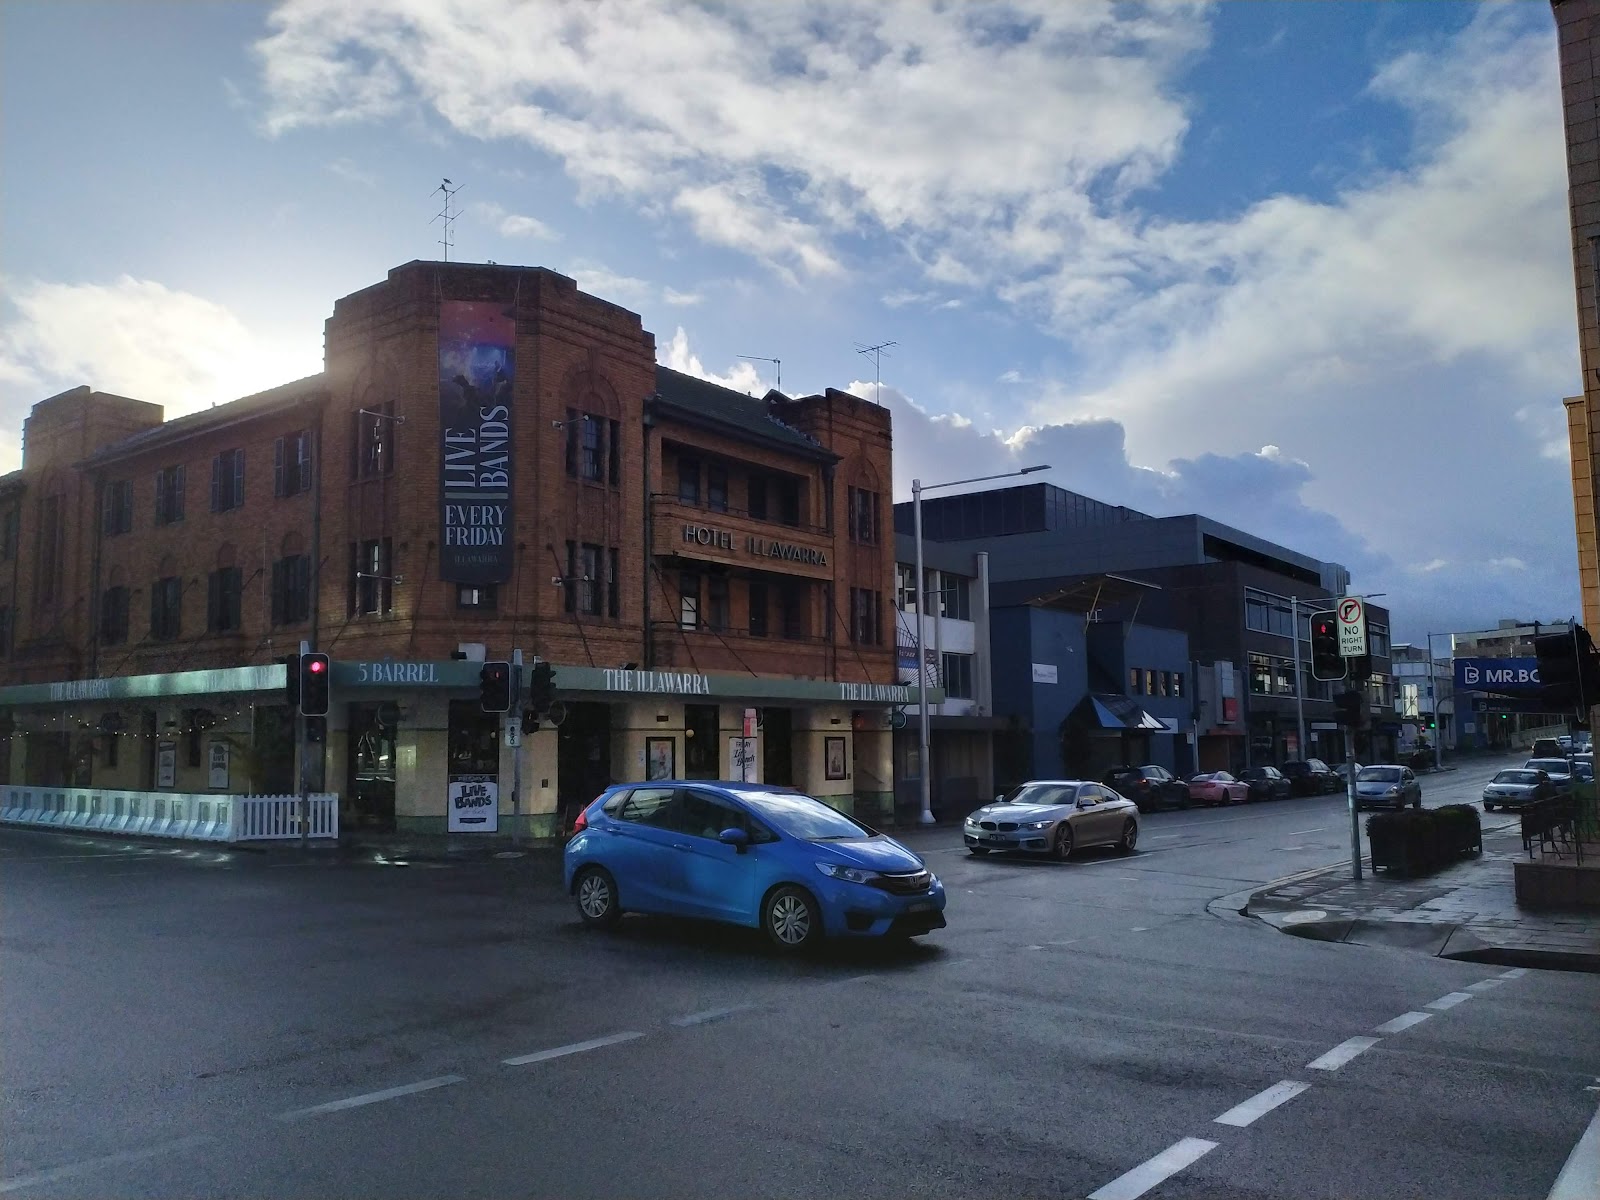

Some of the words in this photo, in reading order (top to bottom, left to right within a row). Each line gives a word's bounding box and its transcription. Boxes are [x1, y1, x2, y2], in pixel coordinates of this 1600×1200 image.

[480, 405, 509, 487] BANDS
[445, 427, 476, 487] LIVE
[445, 505, 507, 525] EVERY
[445, 527, 507, 546] FRIDAY
[683, 523, 737, 550] HOTEL
[748, 535, 828, 566] ILLAWARRA
[1344, 625, 1359, 635] NO
[1341, 636, 1363, 644] RIGHT
[1343, 645, 1363, 653] TURN
[358, 663, 368, 682] 5
[372, 663, 439, 682] BARREL
[603, 669, 633, 691] THE
[636, 671, 710, 694] ILLAWARRA
[839, 682, 859, 700] THE
[860, 684, 909, 702] ILLAWARRA
[461, 785, 487, 798] LIVE
[455, 795, 492, 808] BANDS
